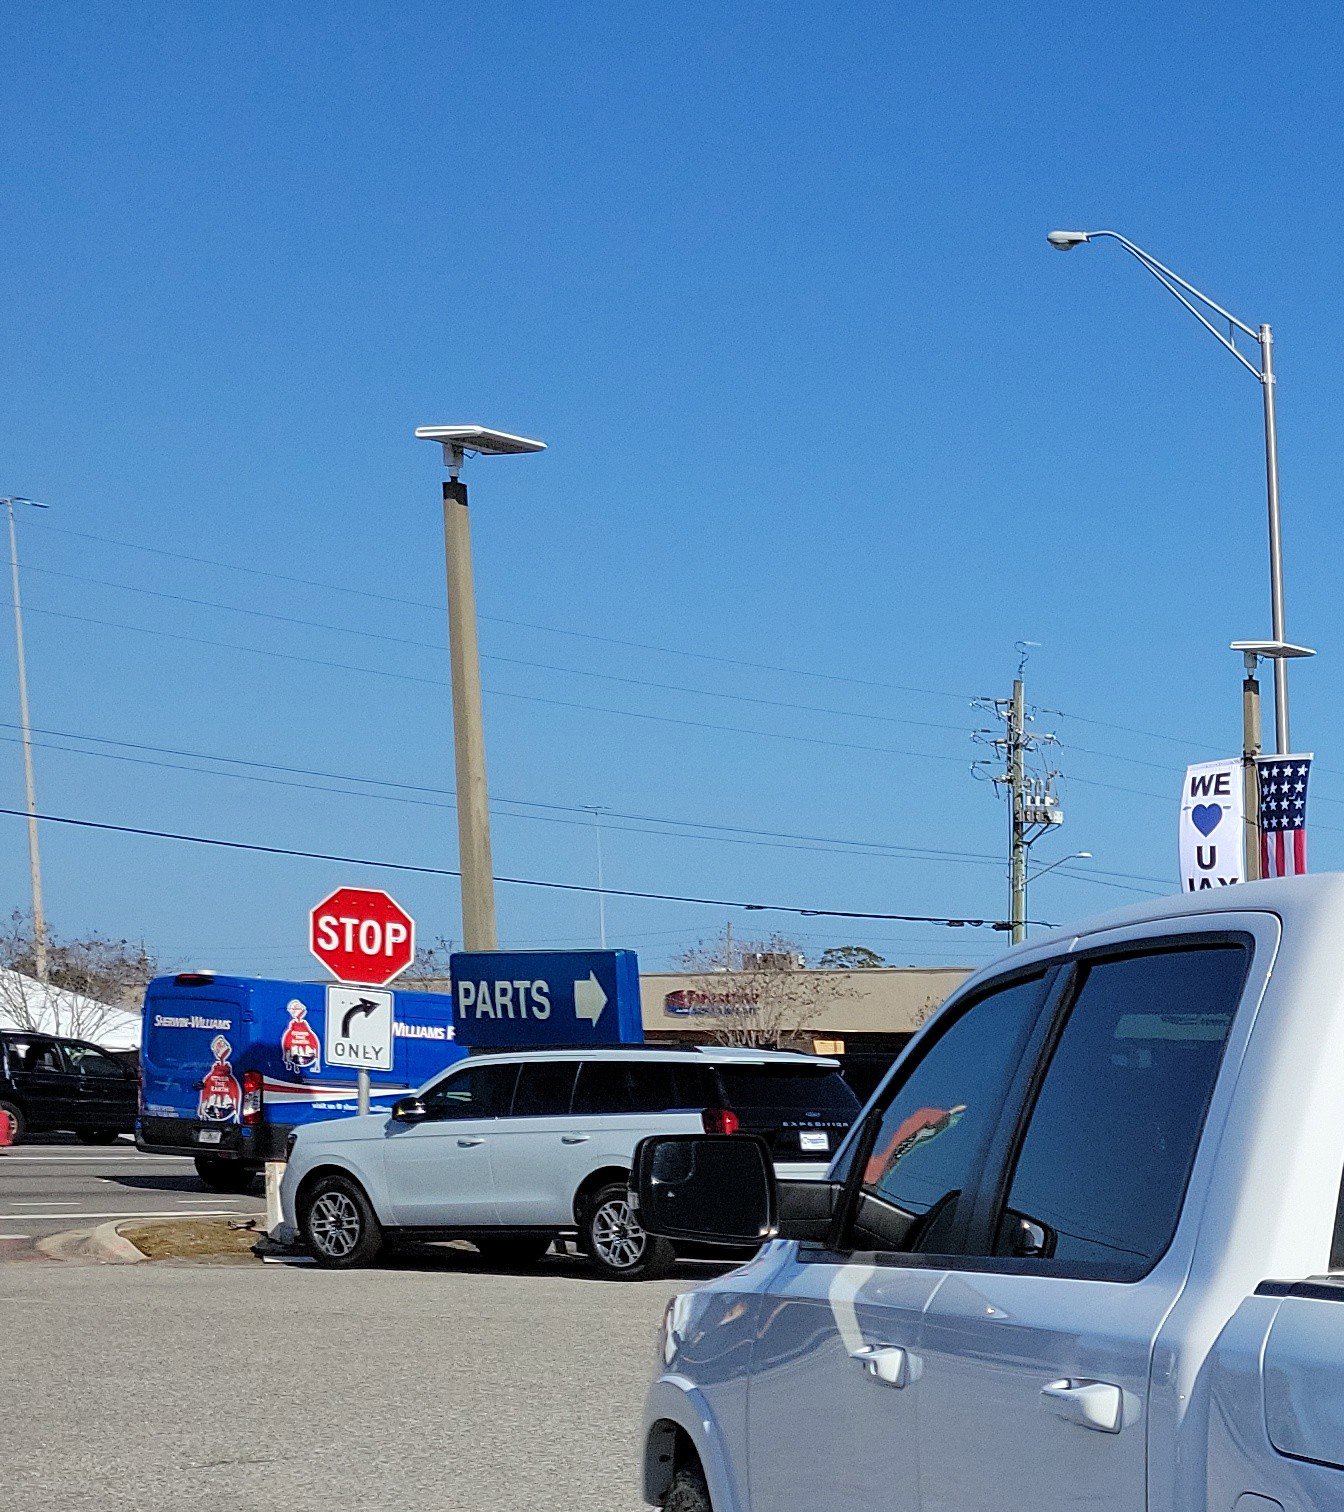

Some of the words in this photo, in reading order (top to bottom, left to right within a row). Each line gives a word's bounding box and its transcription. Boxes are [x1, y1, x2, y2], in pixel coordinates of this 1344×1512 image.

[1190, 771, 1231, 797] WE
[1196, 845, 1217, 870] U
[316, 914, 408, 957] STOP
[457, 980, 551, 1020] PARTS
[334, 1042, 384, 1061] ONLY
